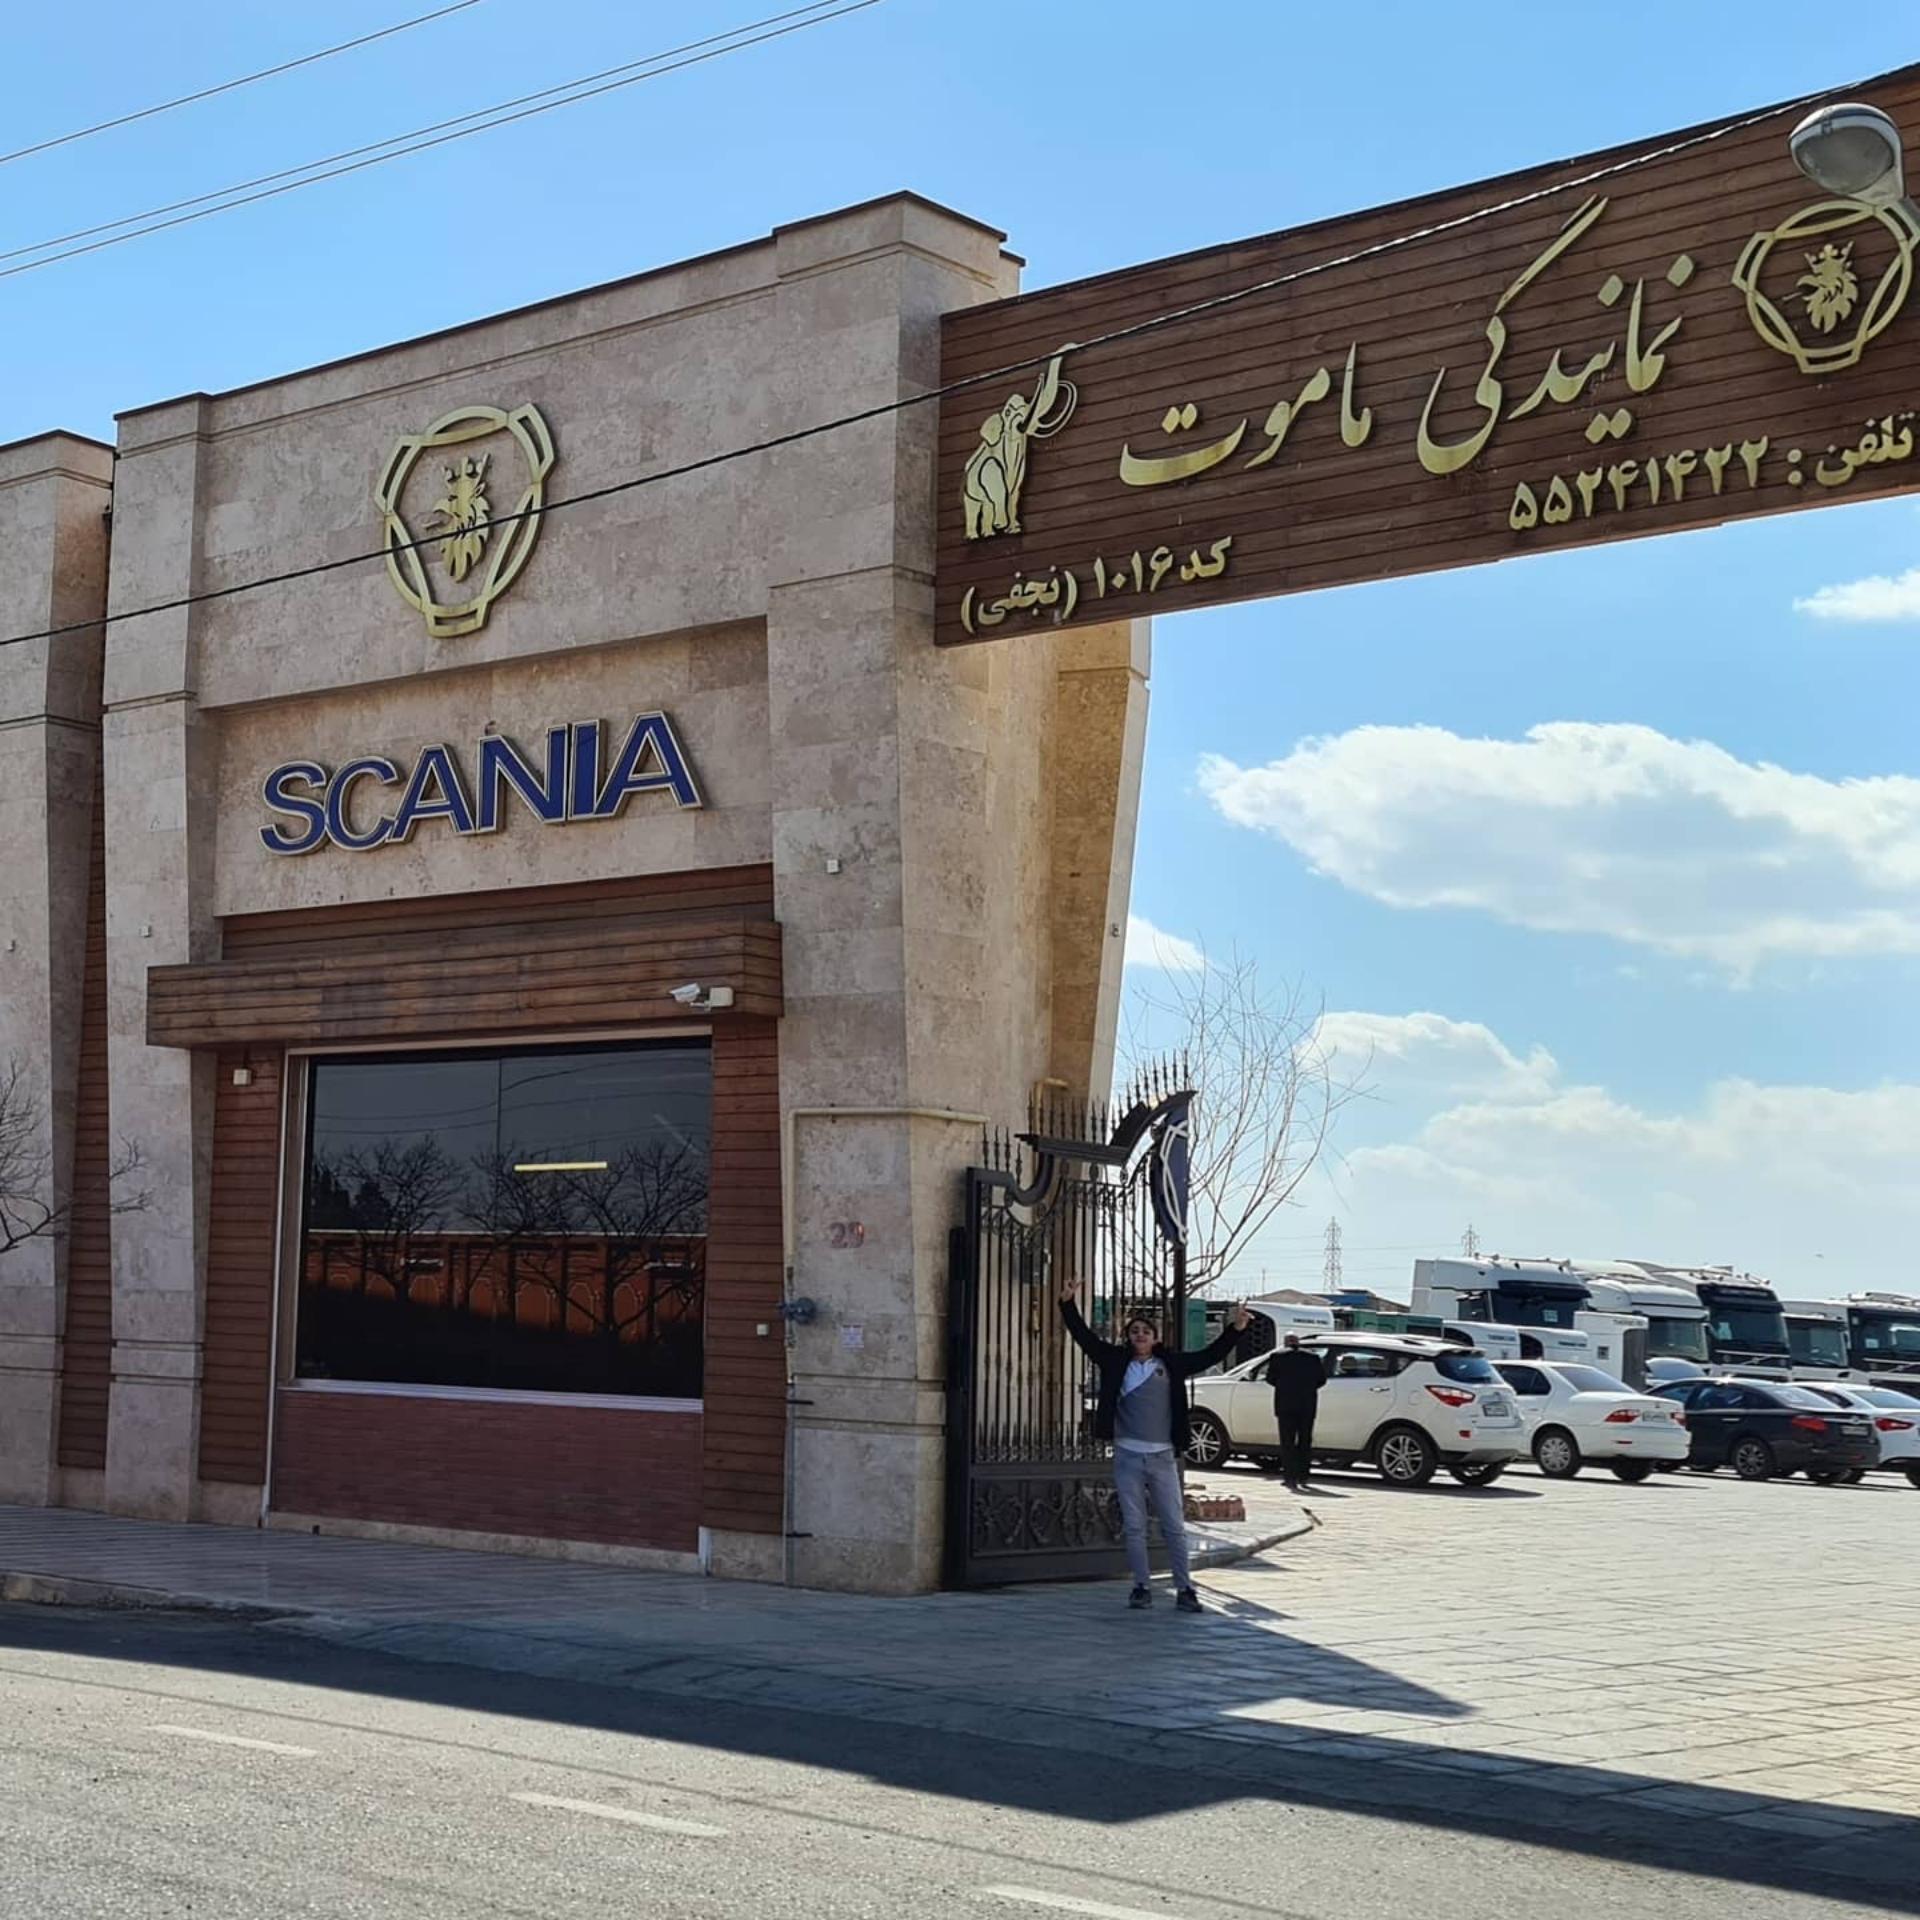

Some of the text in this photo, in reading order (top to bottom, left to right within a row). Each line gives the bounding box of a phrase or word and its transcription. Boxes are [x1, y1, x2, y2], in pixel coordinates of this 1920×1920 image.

[1119, 193, 1695, 487] نمایندگی ماموت
[1509, 435, 1769, 531] ۵۵۲۴۱۴۲۲
[258, 710, 703, 856] SCANIA
[829, 1222, 865, 1249] 29
